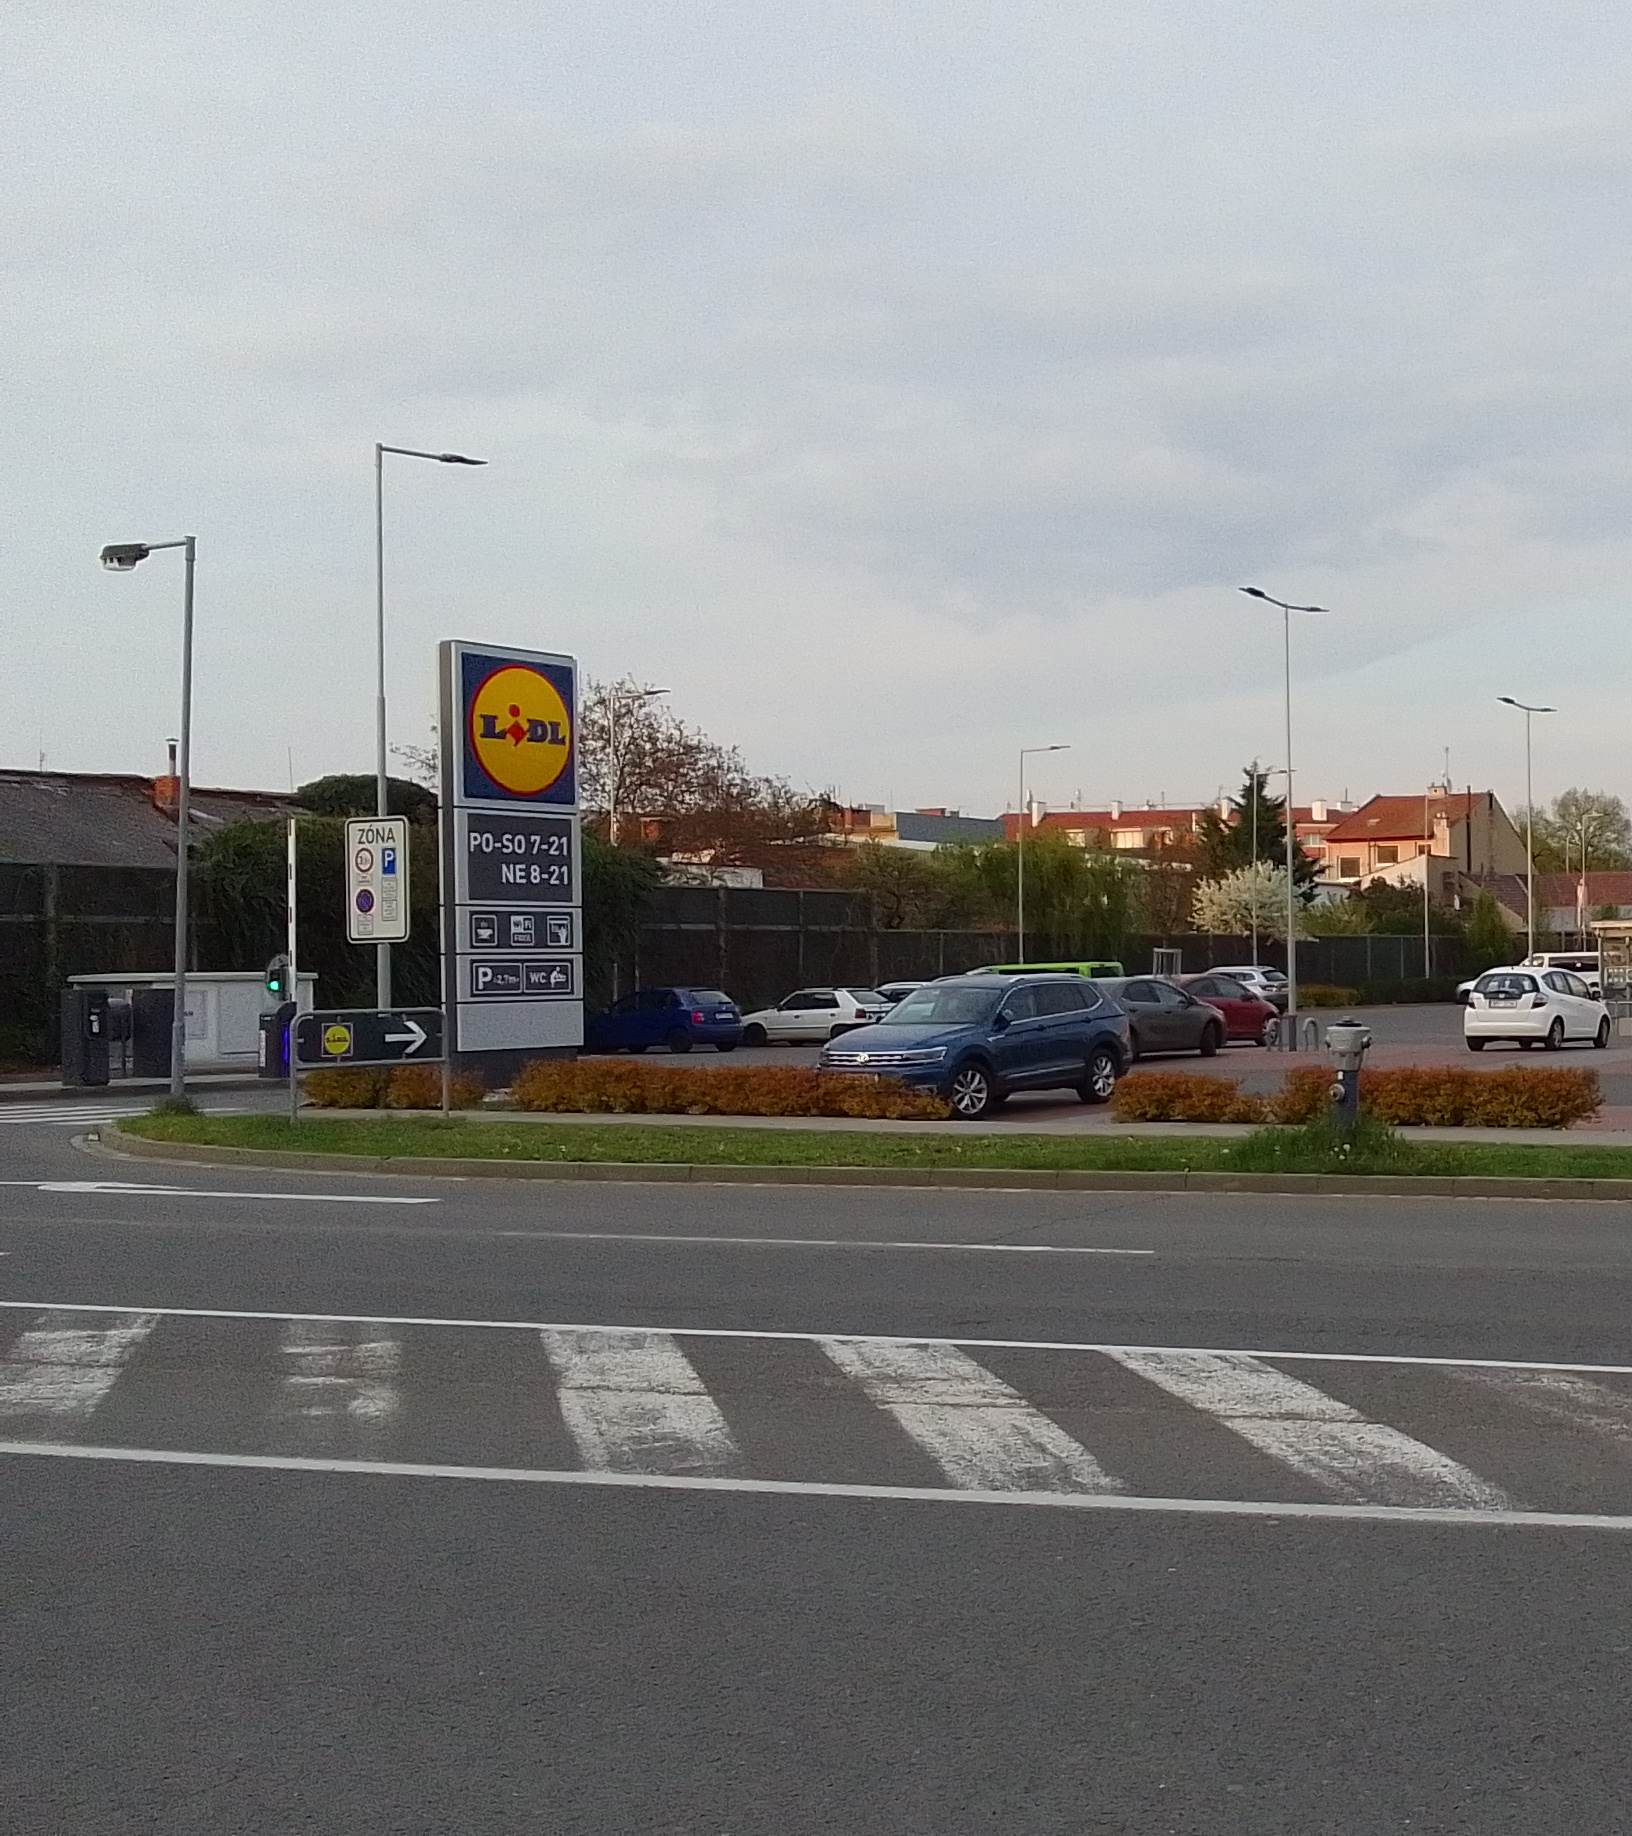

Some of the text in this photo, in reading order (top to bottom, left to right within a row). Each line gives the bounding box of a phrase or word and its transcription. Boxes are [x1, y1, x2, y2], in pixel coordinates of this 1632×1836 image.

[357, 825, 396, 845] ZÓNA
[469, 832, 568, 856] PO-SO 7-21
[384, 850, 394, 867] P
[501, 863, 569, 885] NE 8-21
[478, 966, 492, 990] P
[529, 971, 547, 984] WC
